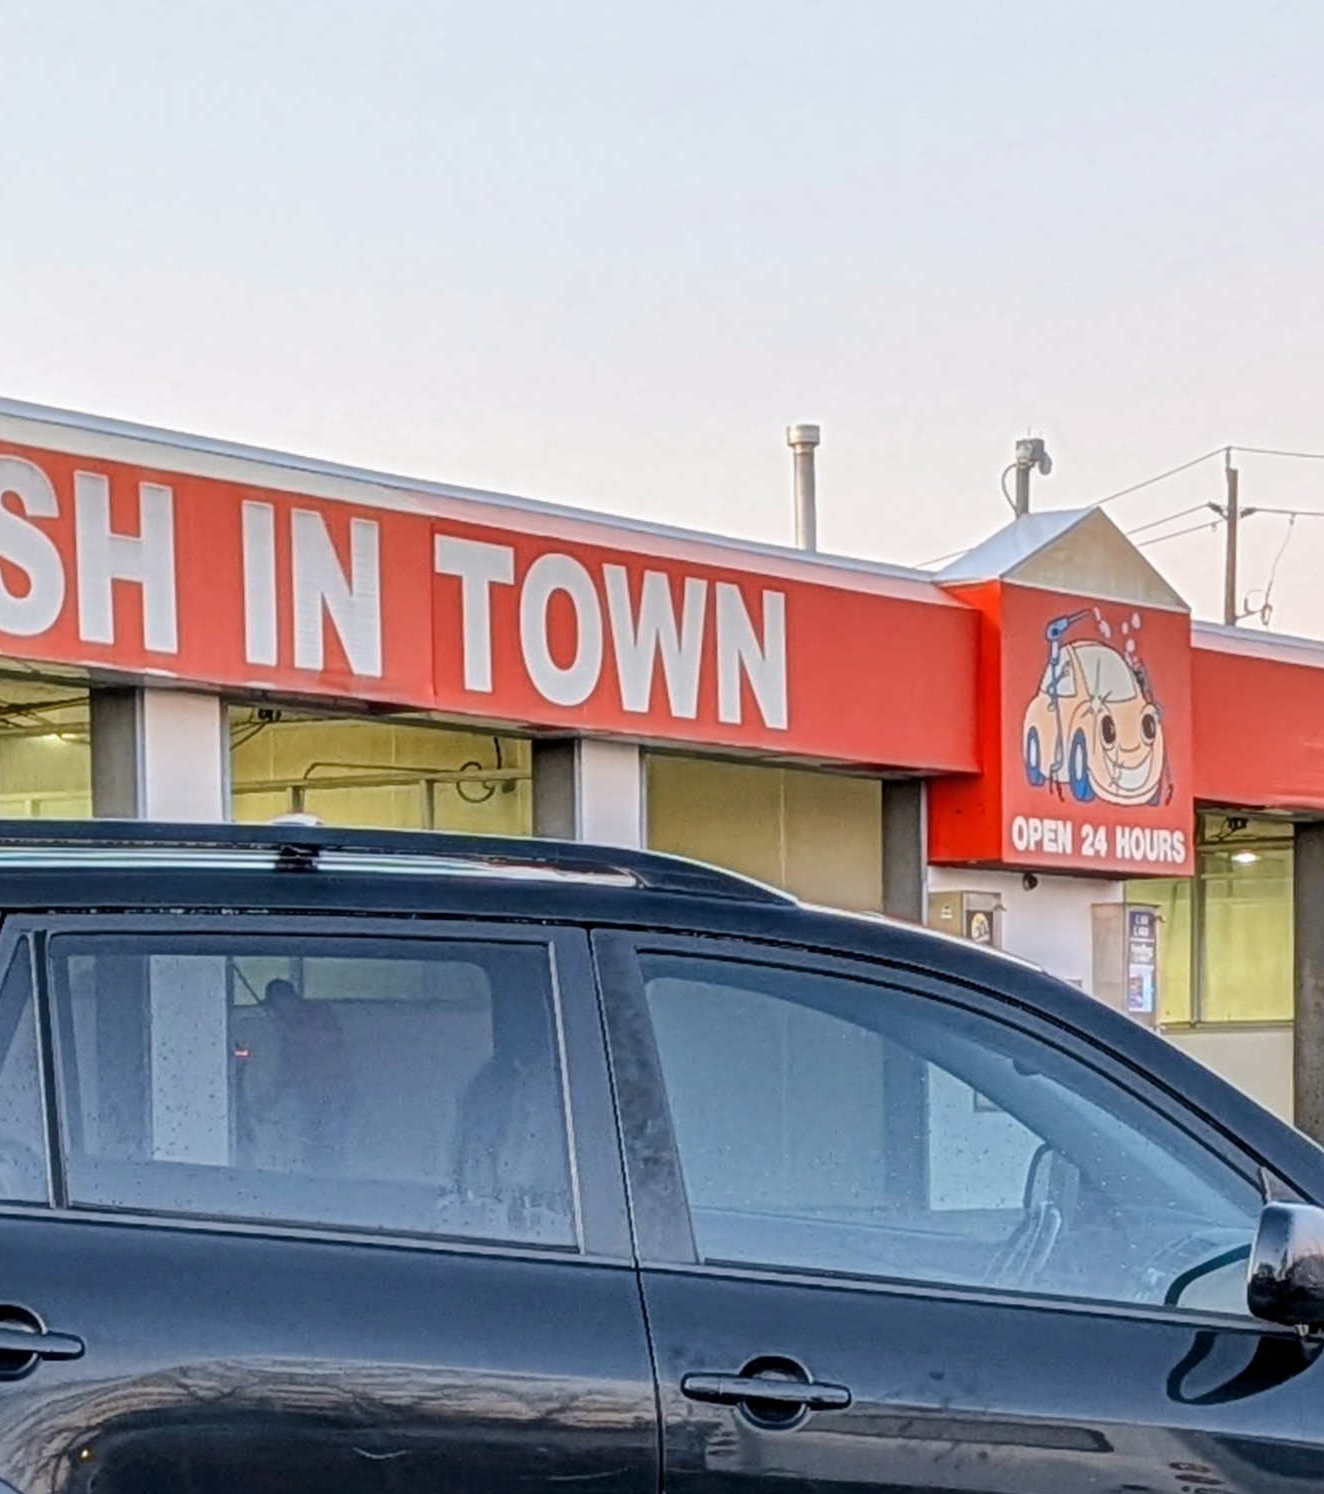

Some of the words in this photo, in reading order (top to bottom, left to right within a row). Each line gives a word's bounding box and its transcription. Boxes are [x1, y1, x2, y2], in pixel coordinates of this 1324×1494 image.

[241, 499, 383, 678] IN
[433, 532, 789, 731] TOWN
[1011, 815, 1073, 855] OPEN
[1080, 822, 1108, 858] 24
[1115, 825, 1186, 864] HOURS
